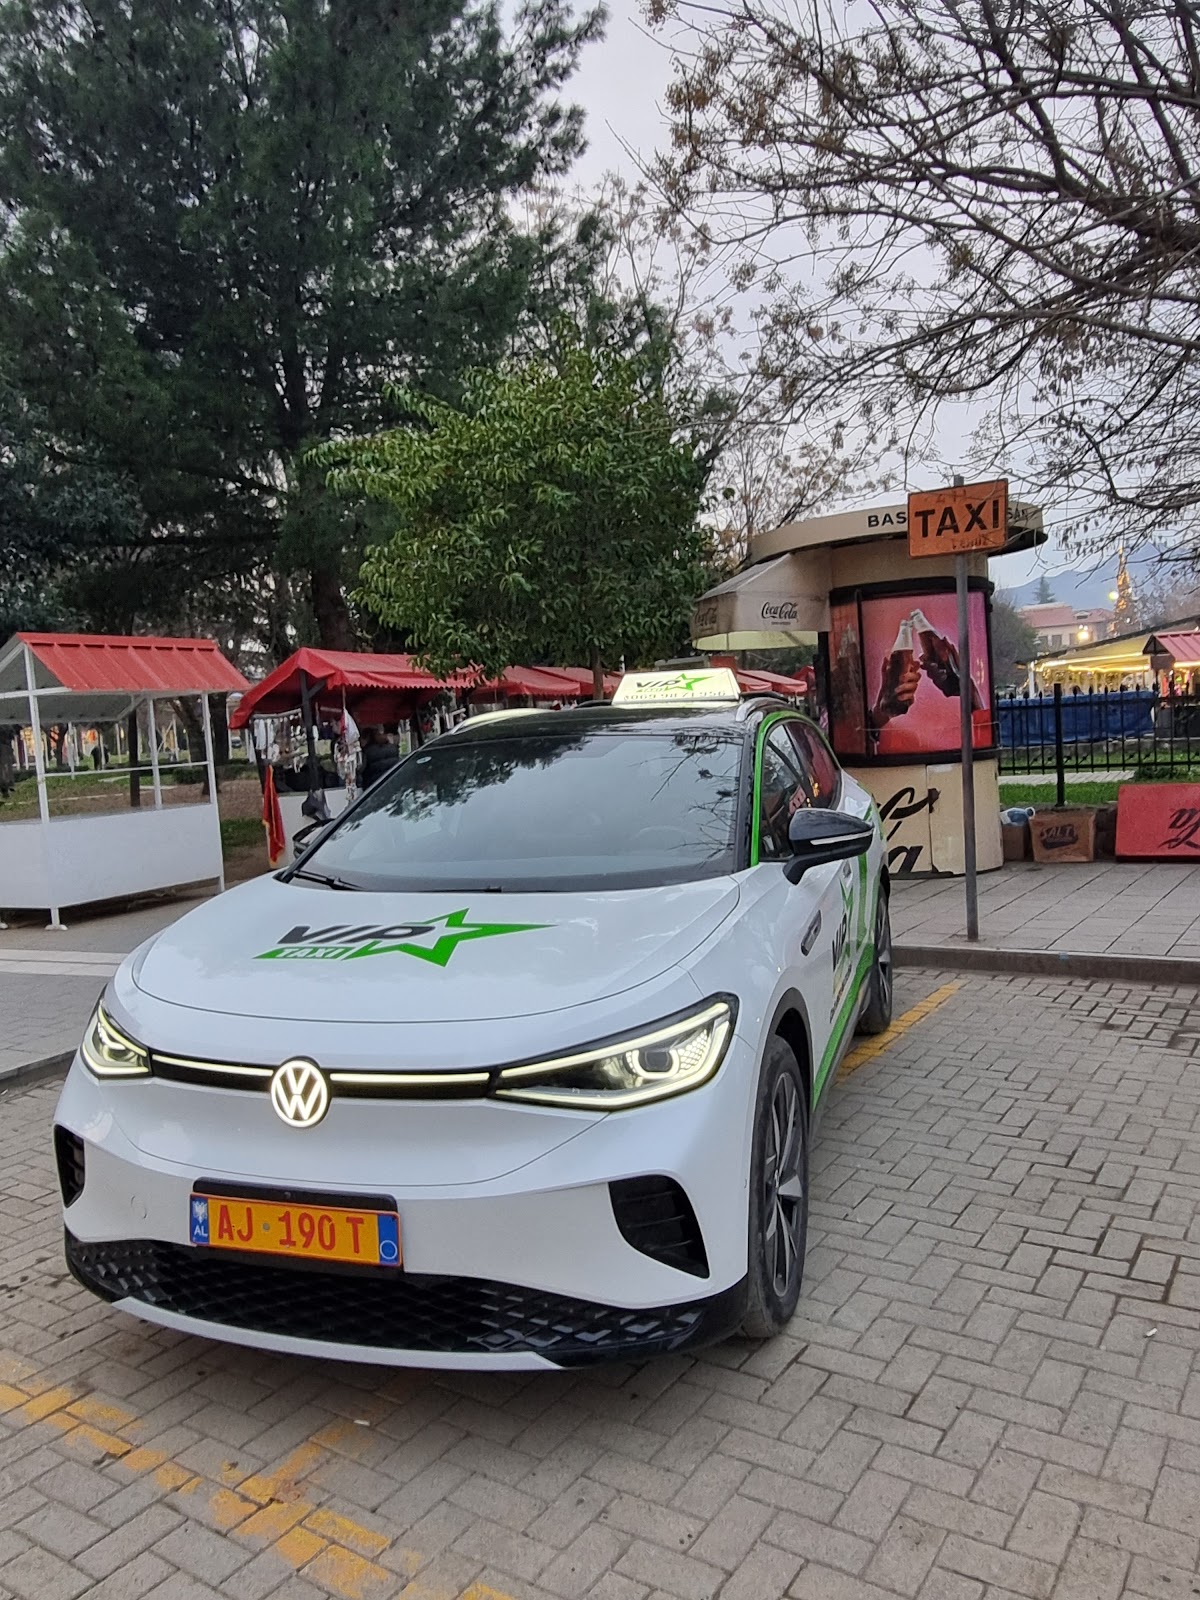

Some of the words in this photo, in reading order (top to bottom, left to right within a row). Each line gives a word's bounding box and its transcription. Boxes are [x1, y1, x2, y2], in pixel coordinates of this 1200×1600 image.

[868, 511, 907, 528] BAS
[914, 500, 1000, 538] TAXI
[636, 679, 682, 688] VIP
[277, 924, 436, 944] VIP
[274, 947, 344, 959] TAXI
[194, 1224, 209, 1237] AL
[217, 1203, 253, 1242] AJ
[277, 1210, 336, 1251] 190
[346, 1216, 365, 1254] T
